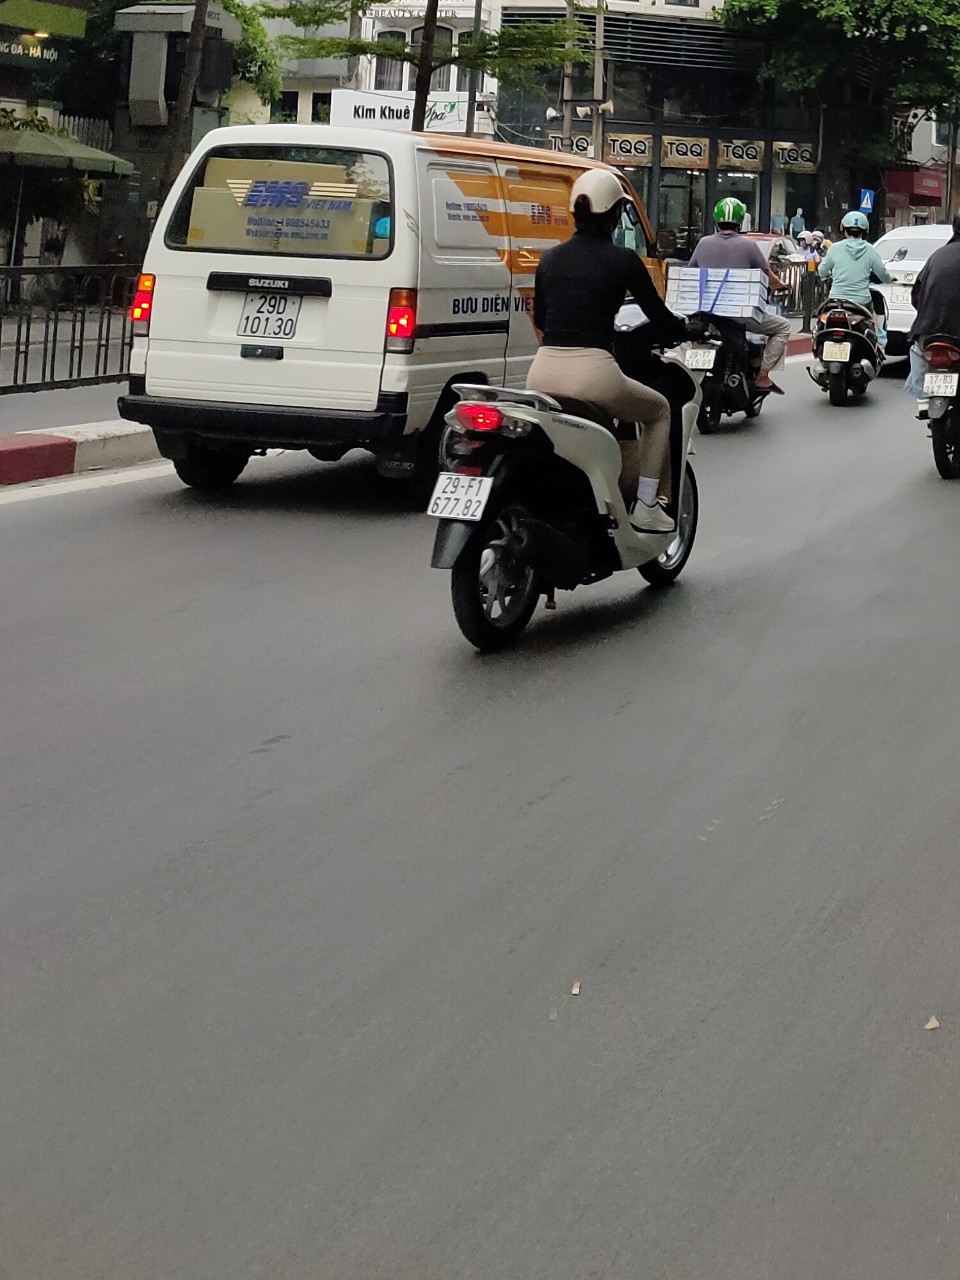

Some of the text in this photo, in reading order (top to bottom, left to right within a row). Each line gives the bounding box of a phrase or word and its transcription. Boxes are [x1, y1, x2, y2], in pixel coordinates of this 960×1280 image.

[417, 9, 458, 18] CTER
[353, 105, 375, 119] Kim
[380, 105, 410, 119] Khuê
[609, 137, 647, 155] TQQ
[666, 140, 703, 158] TQQ
[723, 143, 759, 160] TQQ
[777, 146, 813, 163] TQQ
[248, 278, 289, 288] SUZUKI
[256, 295, 288, 314] 29D
[243, 315, 294, 336] 101.30
[441, 476, 483, 497] 29-F1
[431, 496, 482, 518] 677.82
